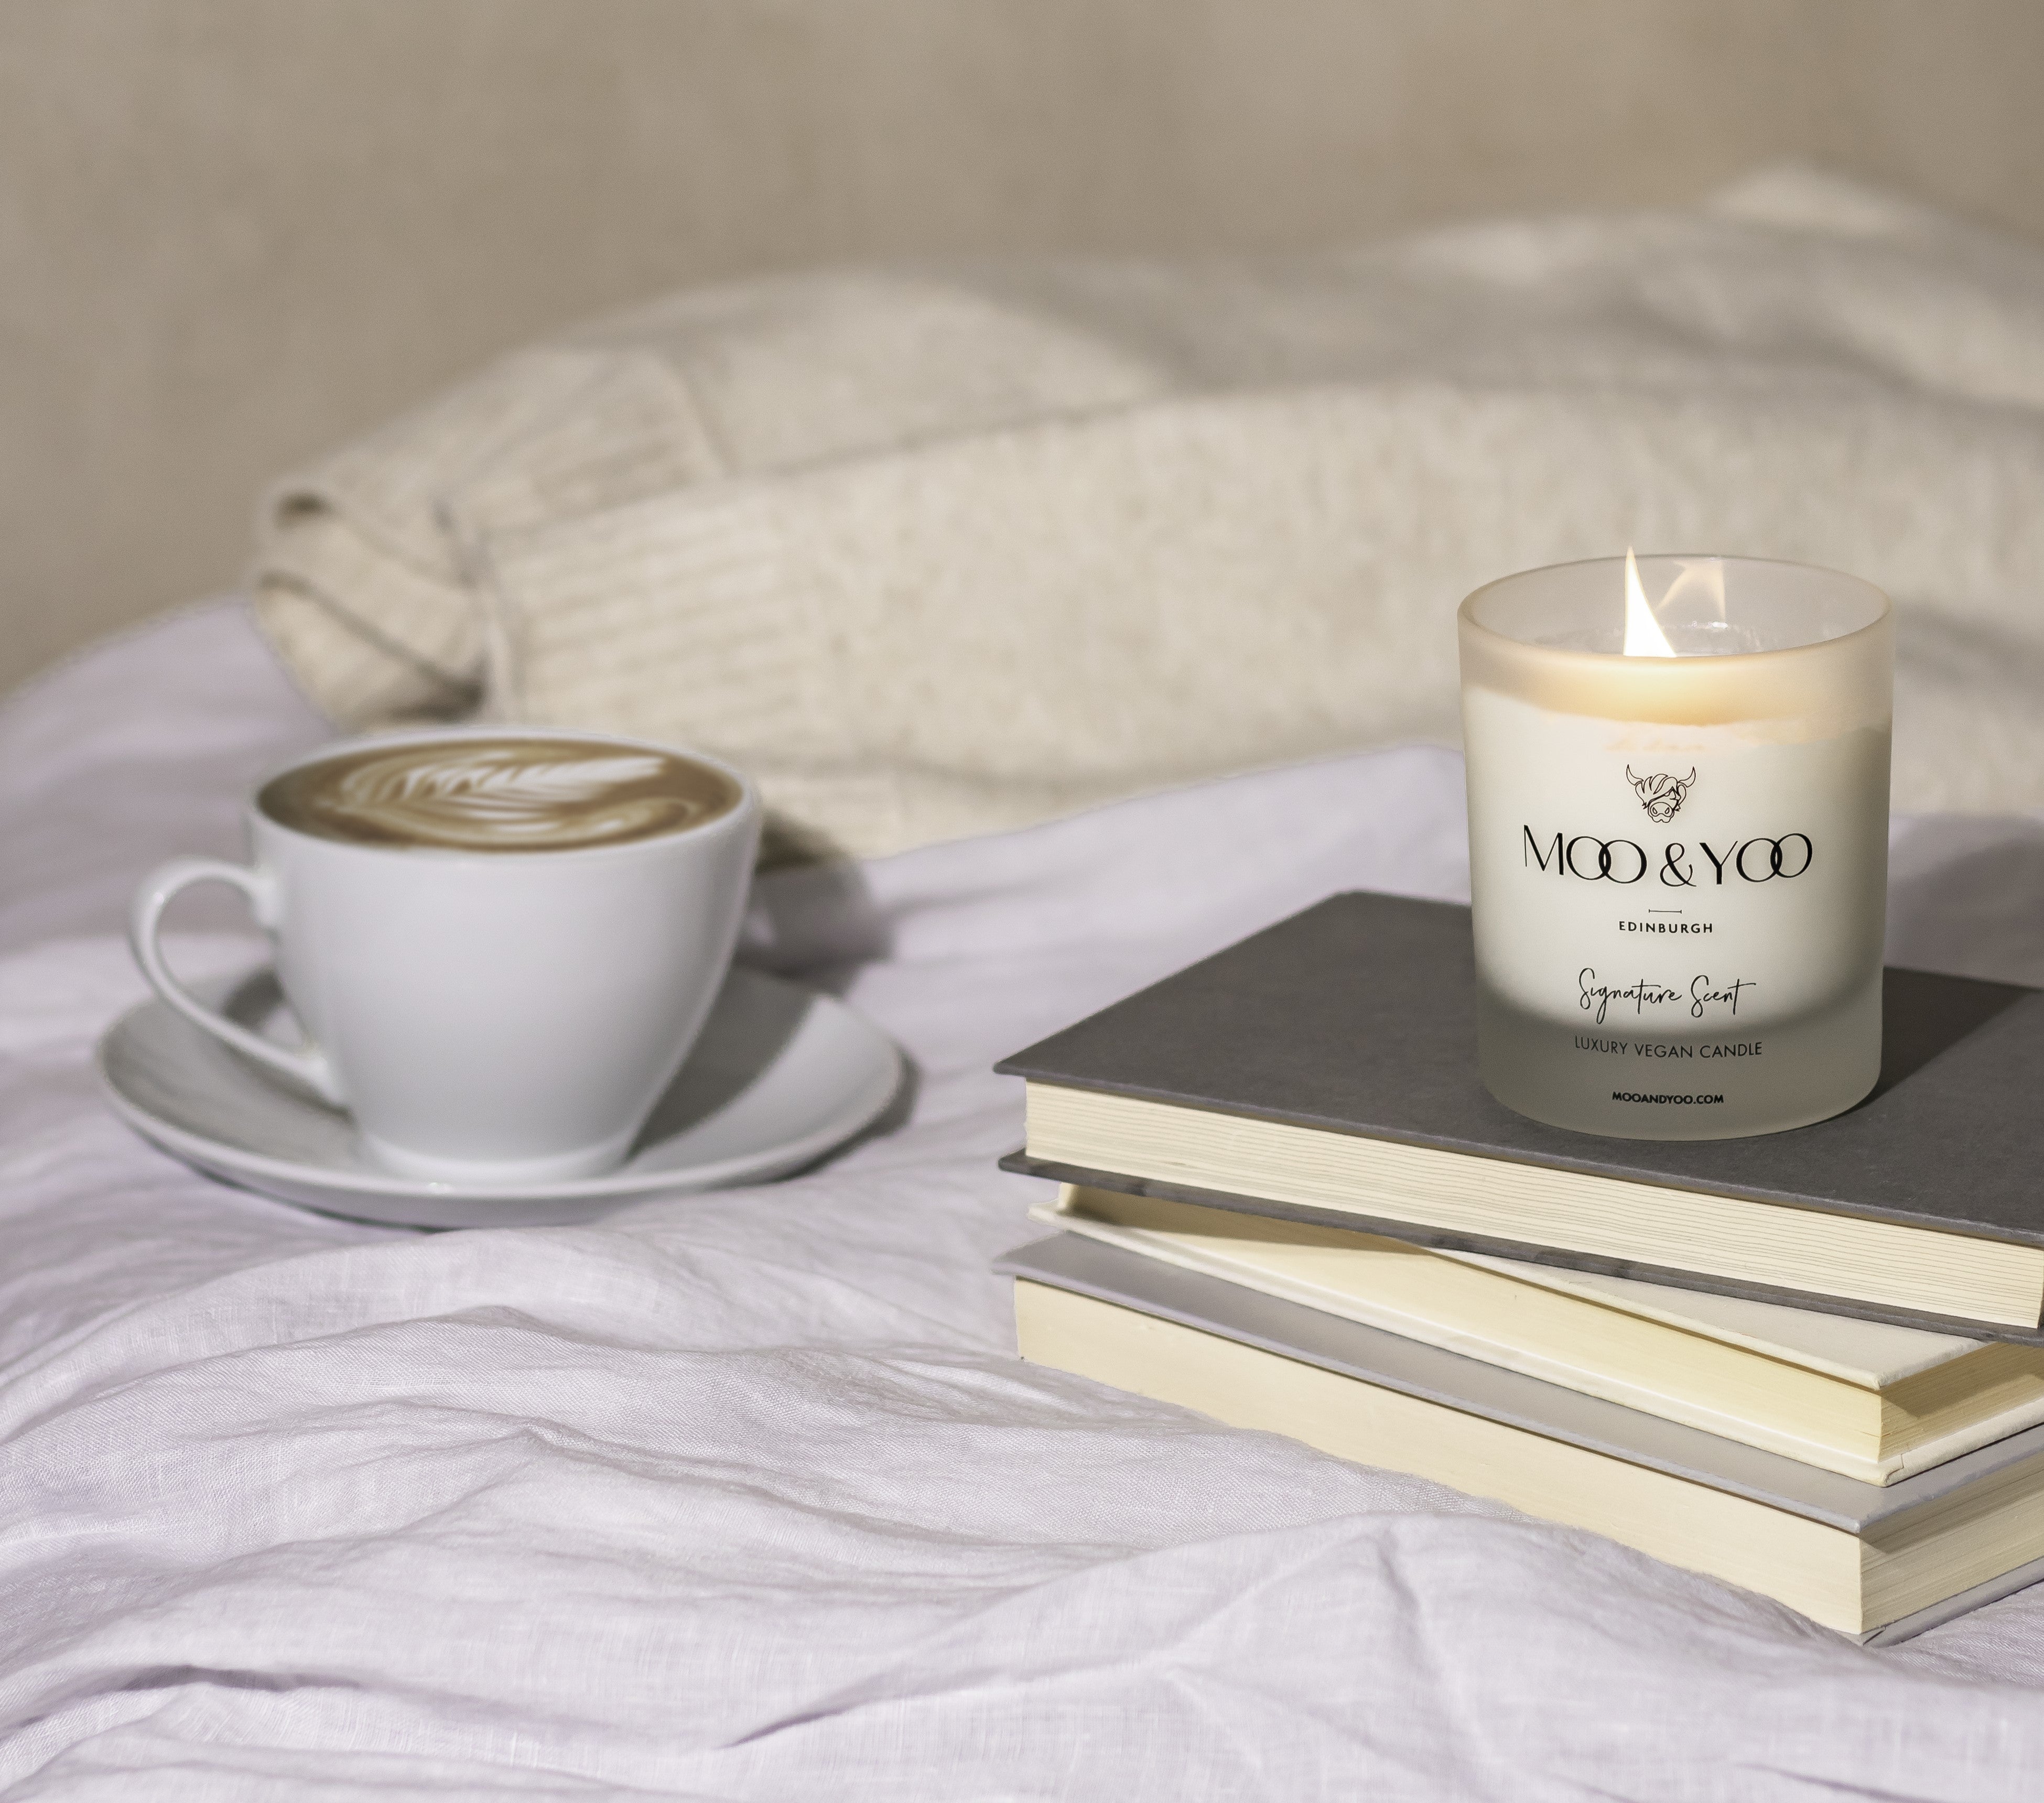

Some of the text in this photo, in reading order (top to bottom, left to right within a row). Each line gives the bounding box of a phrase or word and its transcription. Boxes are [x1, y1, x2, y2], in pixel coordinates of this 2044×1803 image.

[1523, 824, 1647, 884] MOO
[1619, 921, 1713, 934] EDINBURGH
[1578, 968, 1757, 1025] Signature Scent
[1574, 1035, 1762, 1058] LUXURY VEGAN CANDLE
[1612, 1091, 1724, 1105] MOOANDYOO.COM
